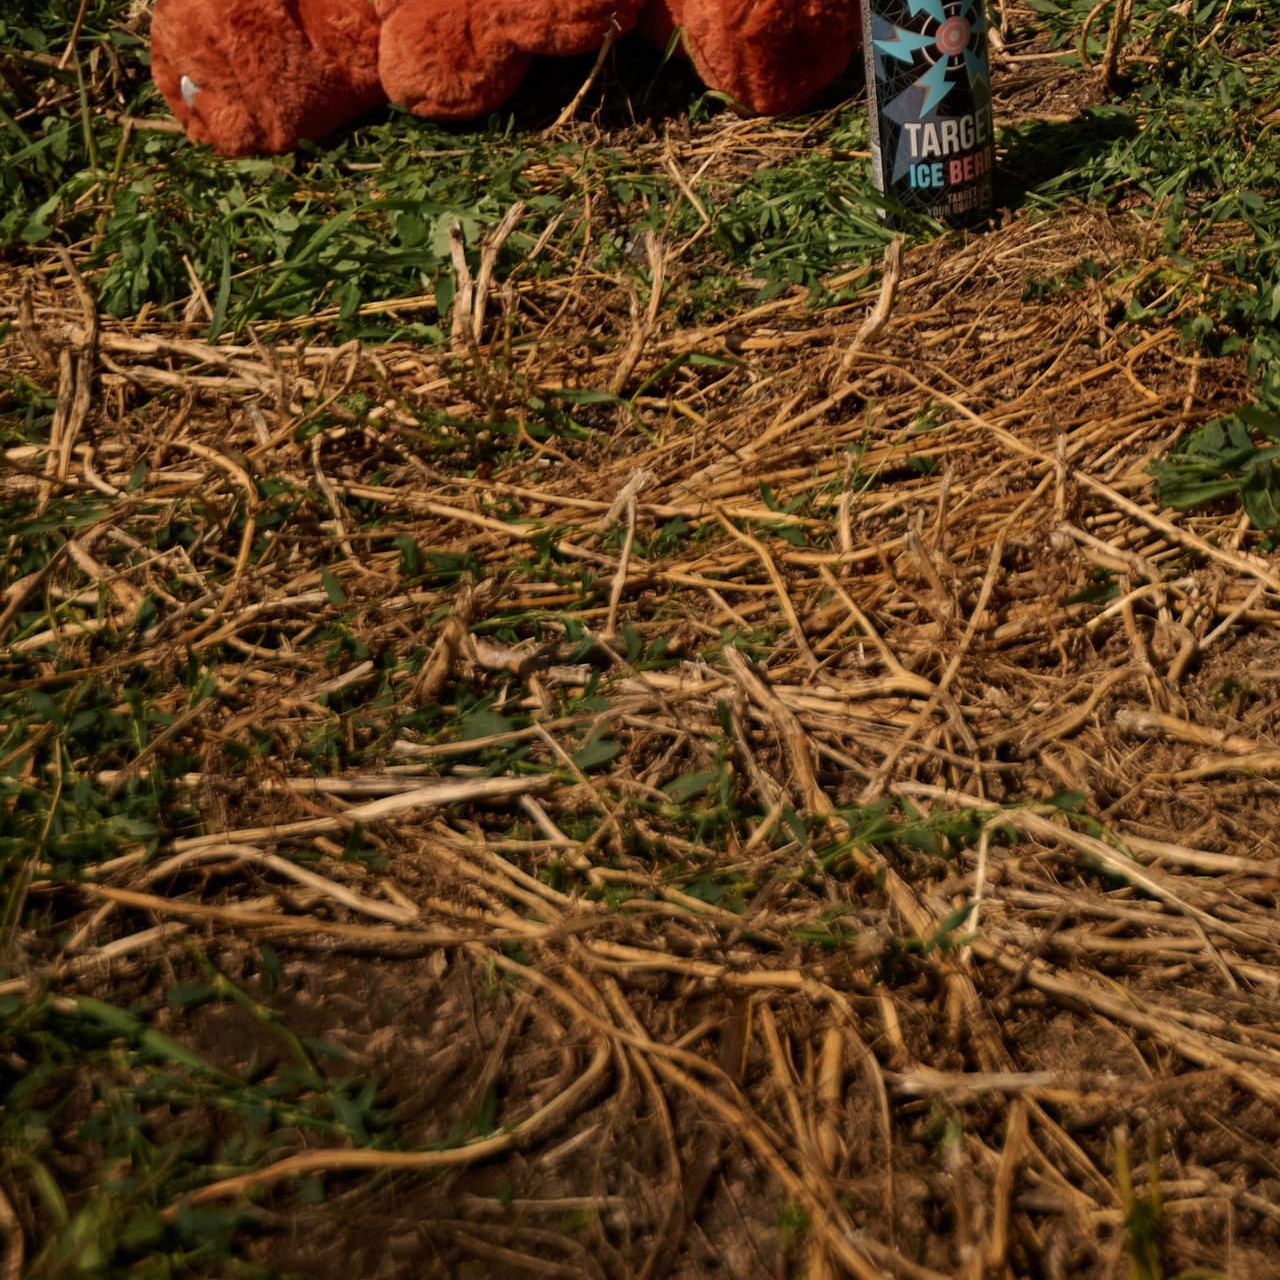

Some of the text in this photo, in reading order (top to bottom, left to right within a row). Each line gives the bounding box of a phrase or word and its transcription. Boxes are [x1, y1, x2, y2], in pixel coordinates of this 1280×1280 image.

[909, 162, 945, 188] ICE
[947, 185, 977, 204] TARGET
[926, 203, 951, 217] YOUR
